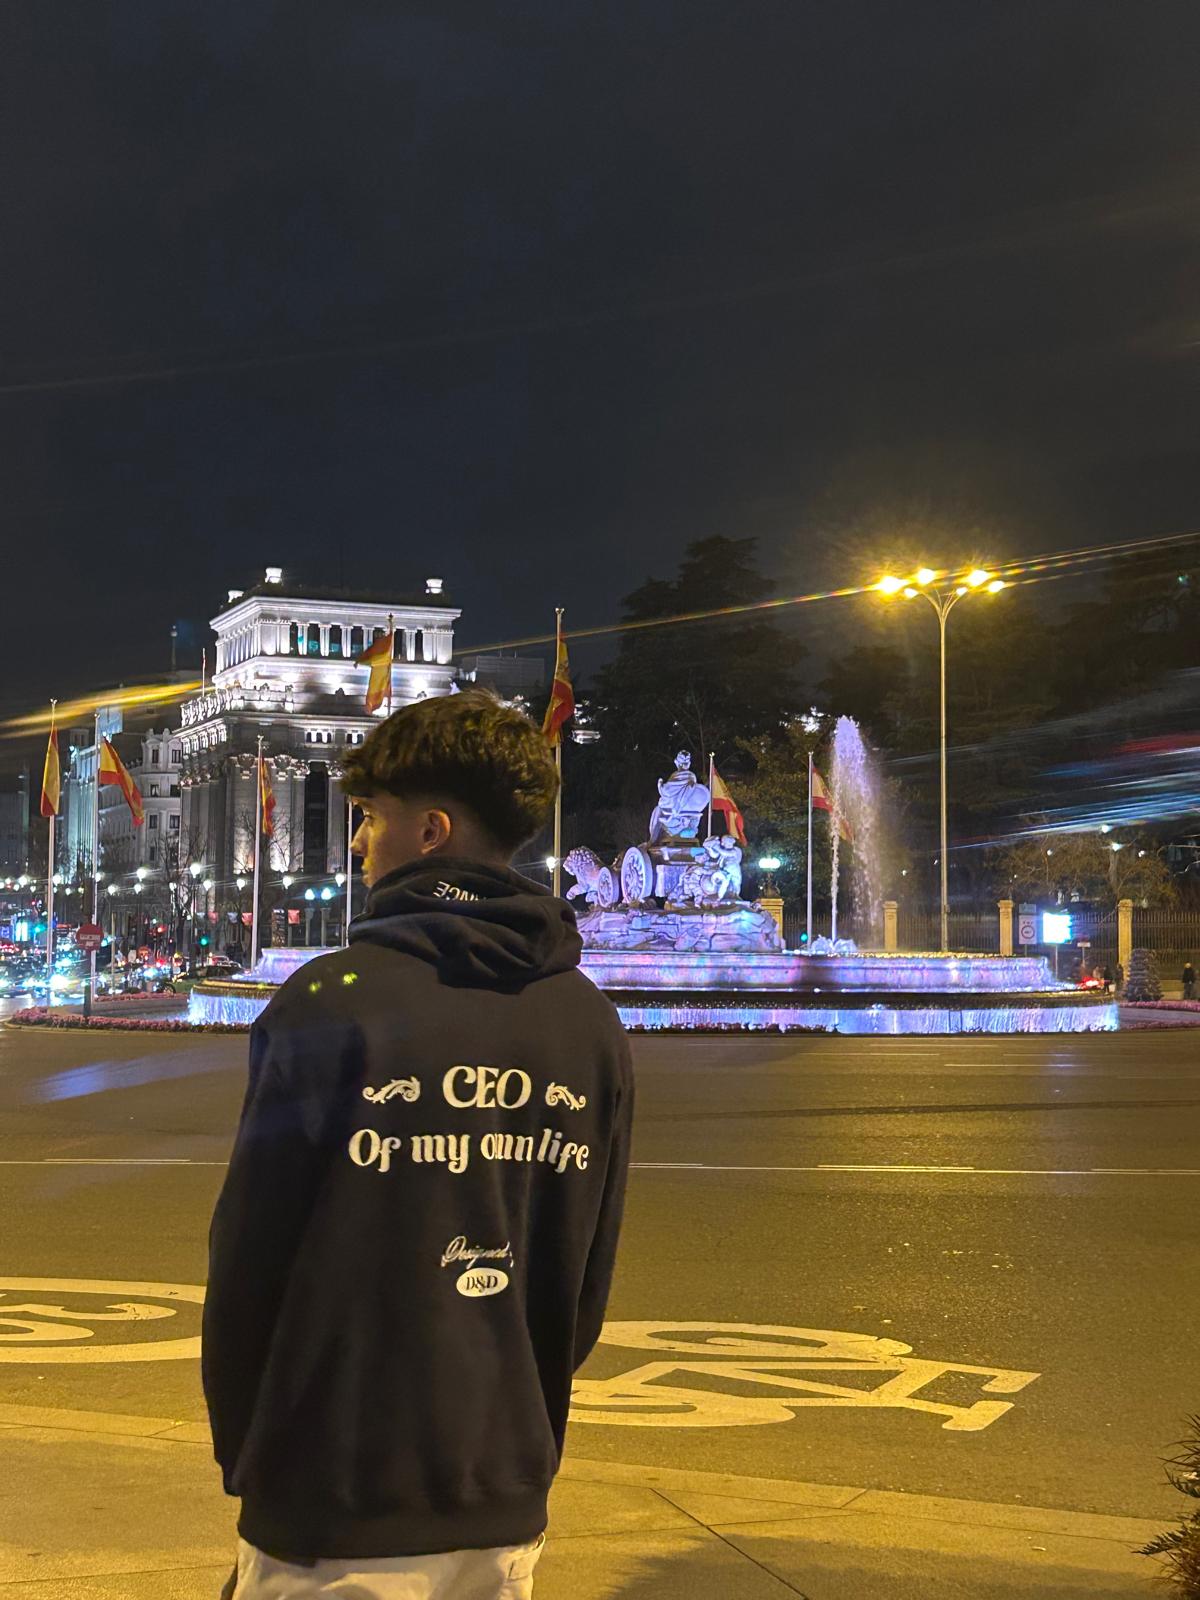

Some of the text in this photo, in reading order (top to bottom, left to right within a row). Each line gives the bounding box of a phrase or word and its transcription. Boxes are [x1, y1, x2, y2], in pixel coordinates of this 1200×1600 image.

[442, 1065, 532, 1109] CEO
[349, 1128, 401, 1173] Of
[410, 1133, 471, 1174] my
[536, 1128, 589, 1173] life
